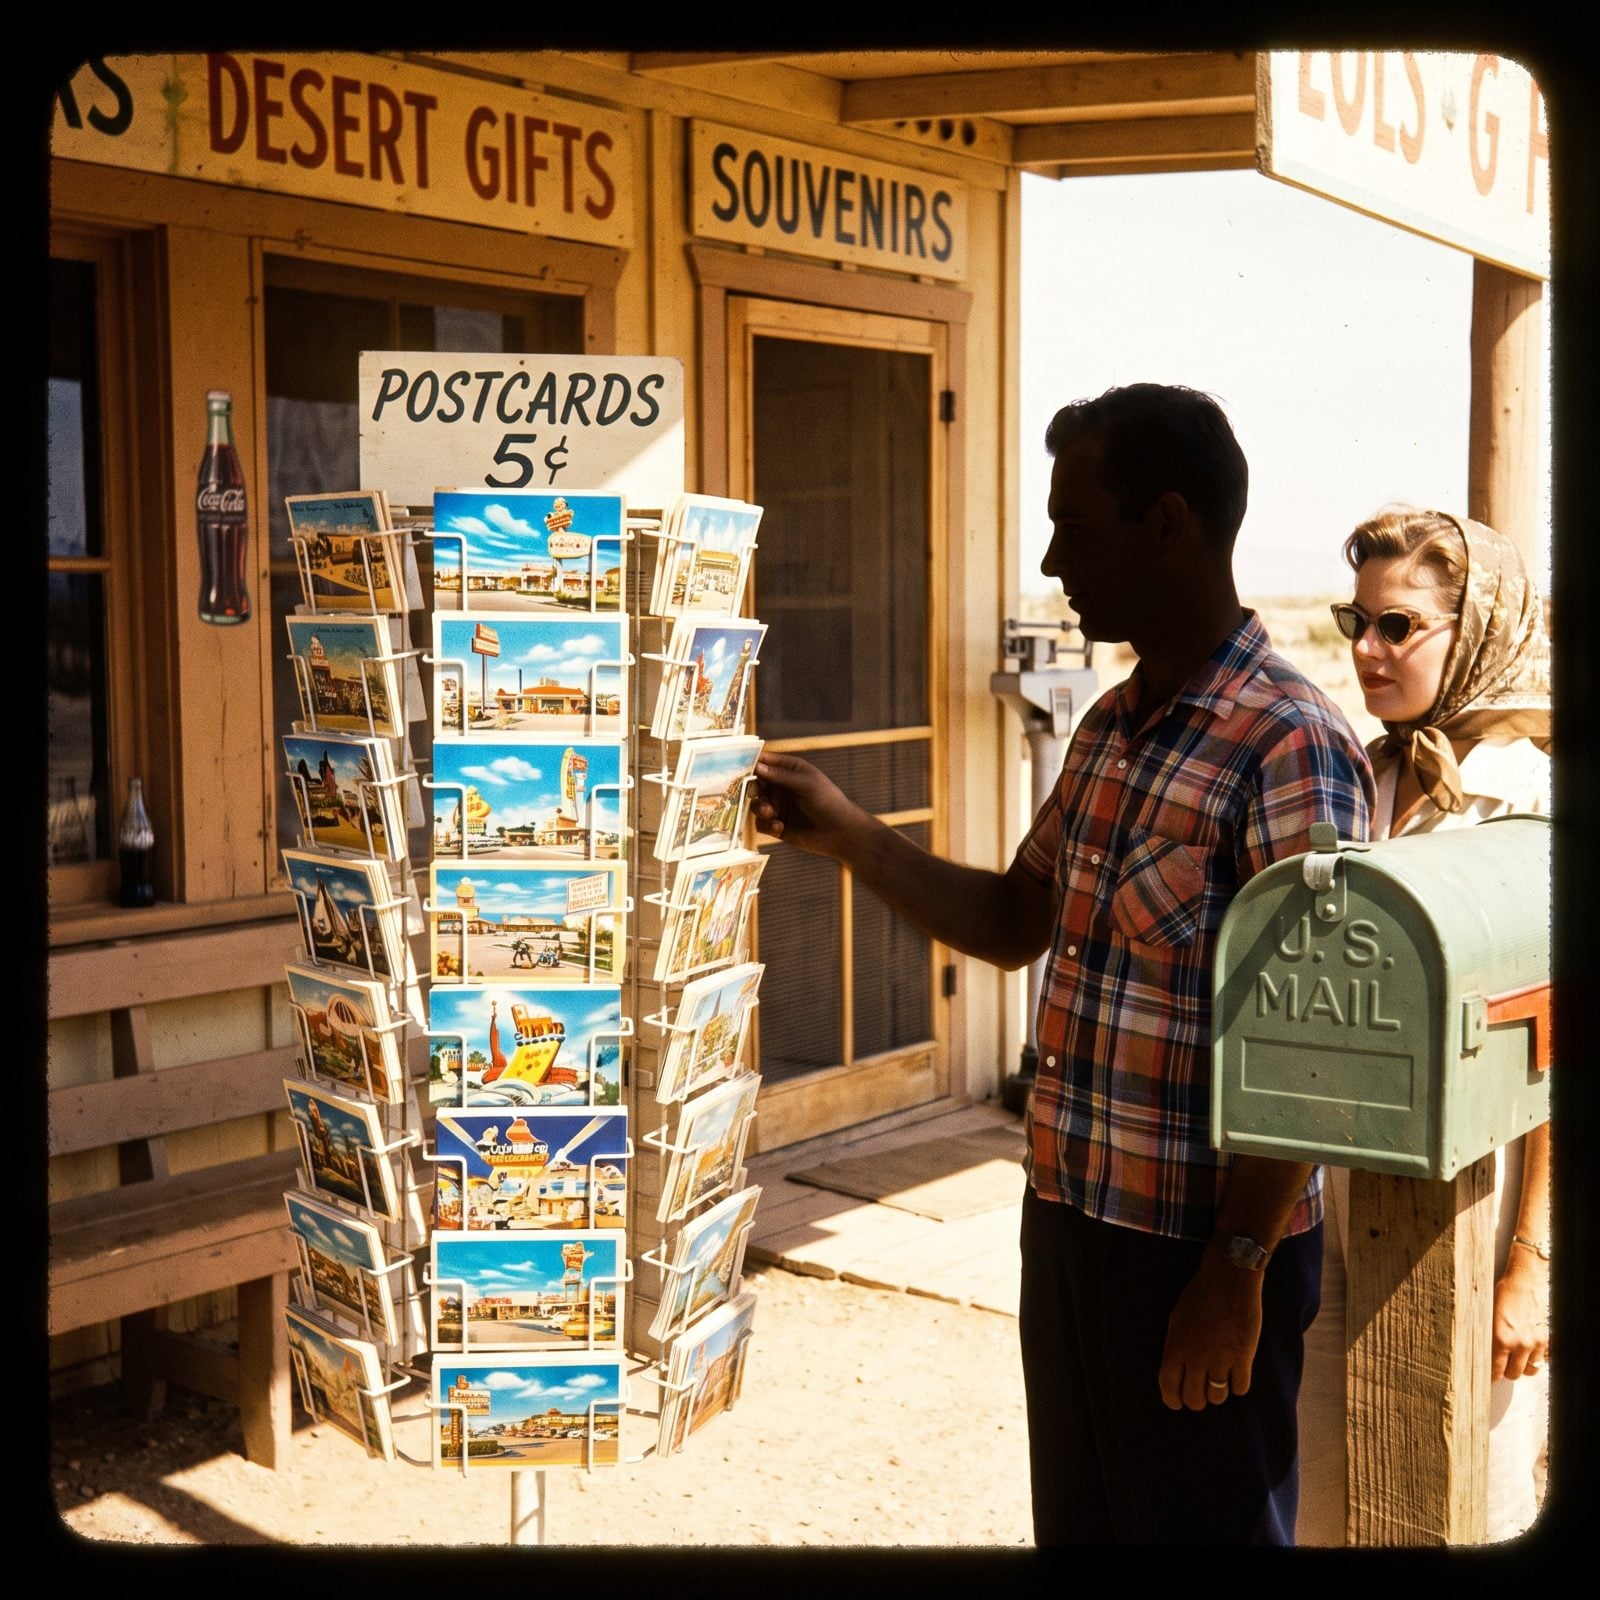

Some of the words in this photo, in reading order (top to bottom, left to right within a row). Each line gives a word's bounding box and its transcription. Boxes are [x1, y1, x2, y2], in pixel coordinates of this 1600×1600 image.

[207, 53, 438, 190] DESERT
[464, 105, 616, 221] GIFTS
[711, 142, 954, 262] SOUVENIRS
[371, 368, 665, 427] POSTCARDS
[1255, 971, 1401, 1032] MAIL
